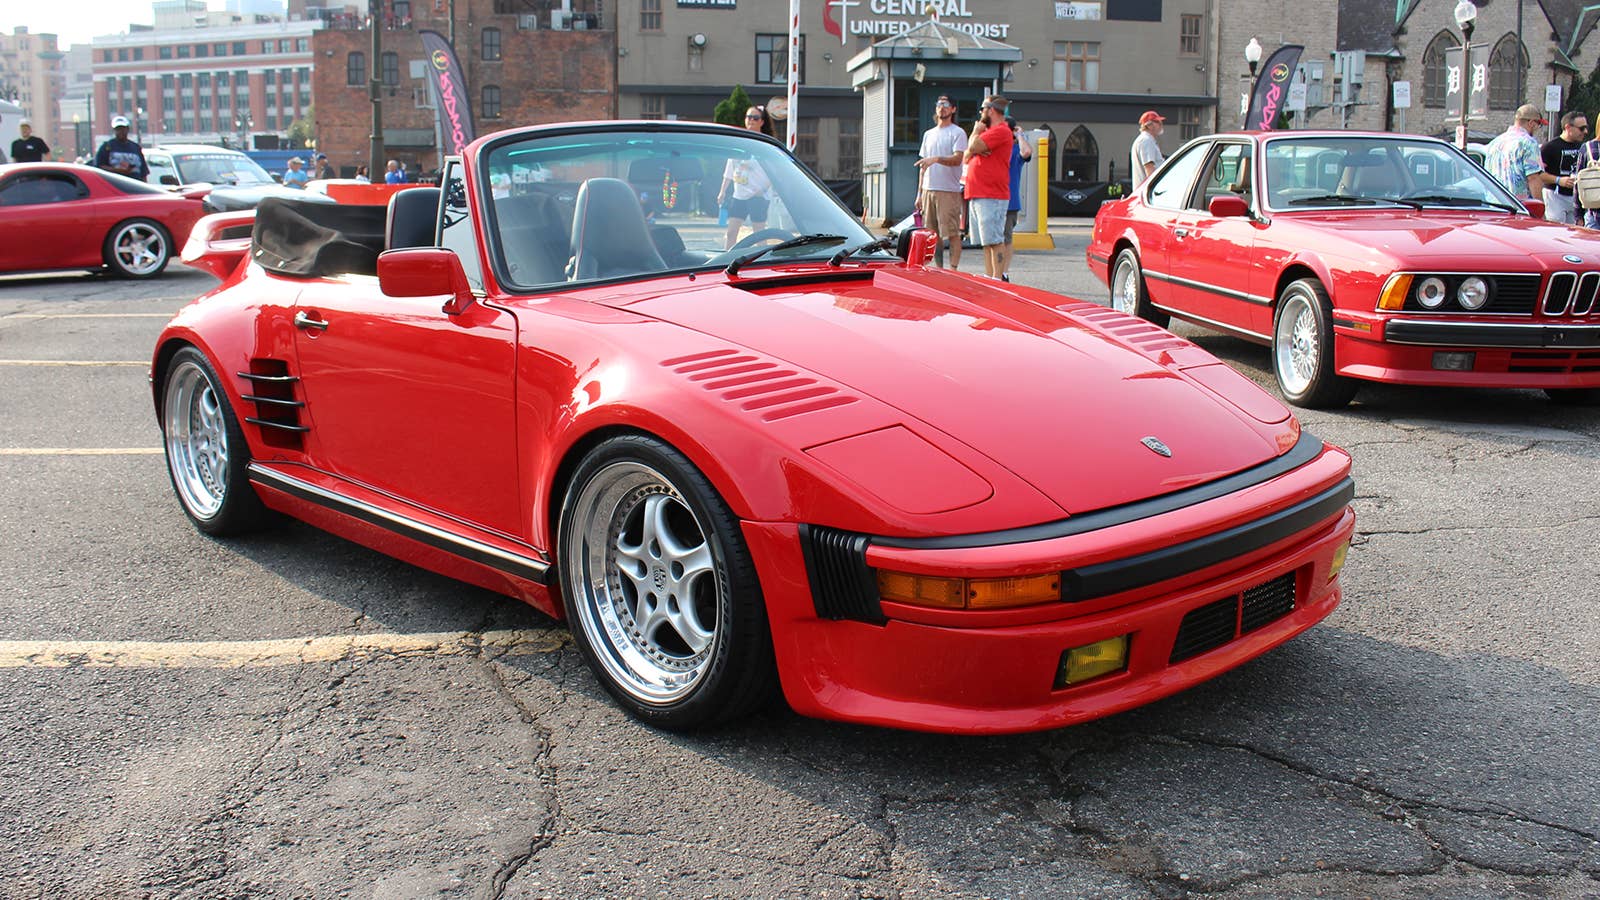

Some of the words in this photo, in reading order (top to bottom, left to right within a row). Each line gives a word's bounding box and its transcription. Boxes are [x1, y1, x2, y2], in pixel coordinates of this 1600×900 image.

[870, 0, 973, 17] CENTRAL
[850, 20, 911, 35] UNITED
[915, 21, 1010, 38] HODIST
